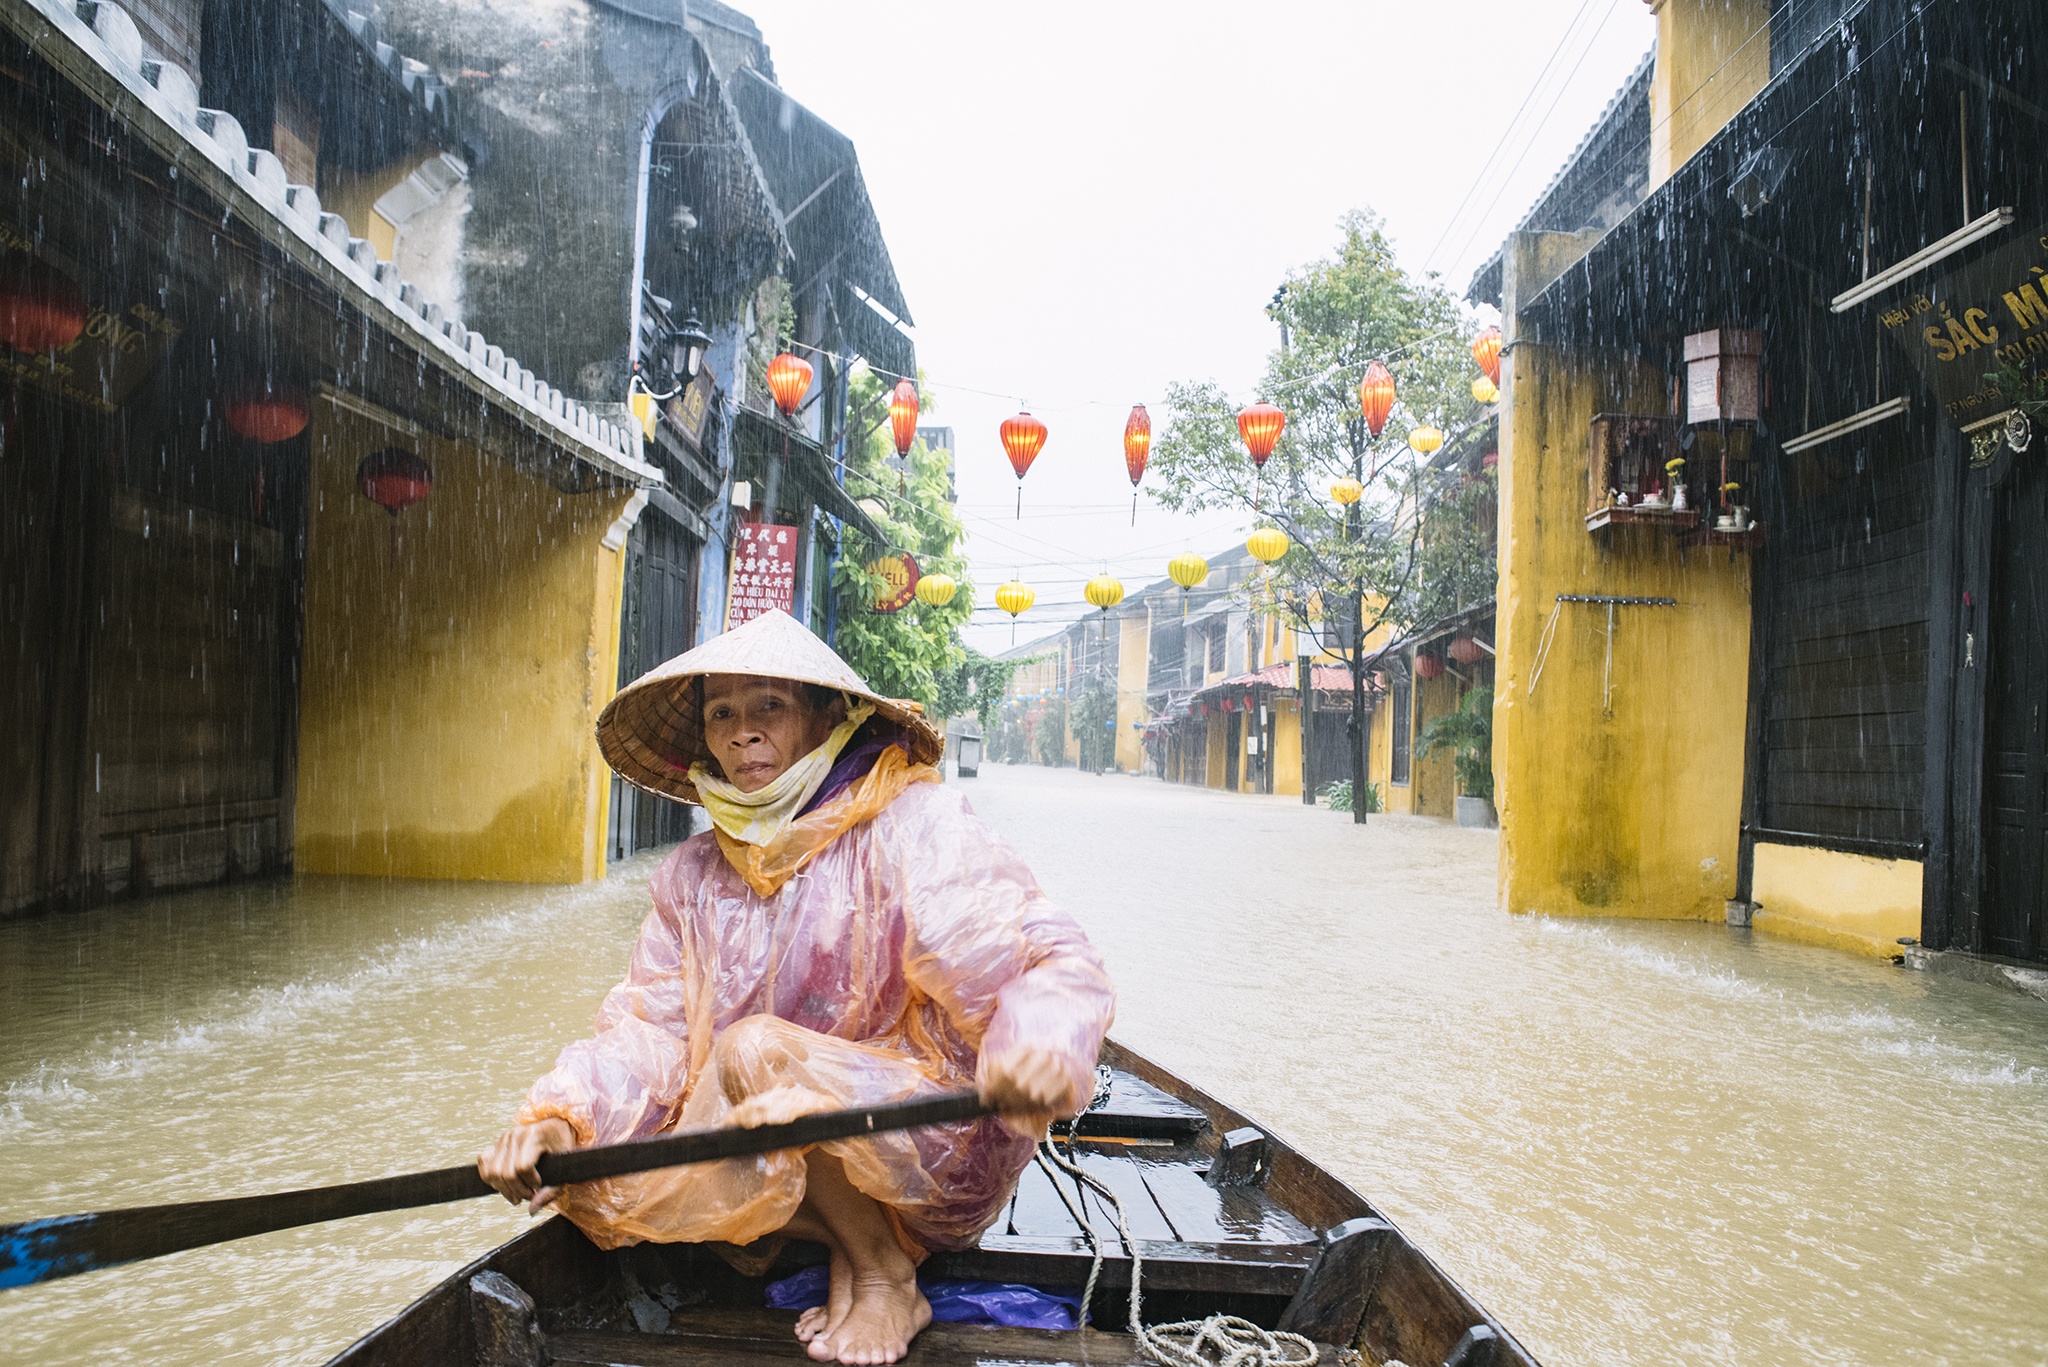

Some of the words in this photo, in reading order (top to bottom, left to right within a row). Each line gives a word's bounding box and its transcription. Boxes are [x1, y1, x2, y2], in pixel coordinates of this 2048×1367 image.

[1881, 309, 1911, 330] Hiệu
[1925, 301, 1999, 362] SẮC
[869, 571, 905, 586] ELL
